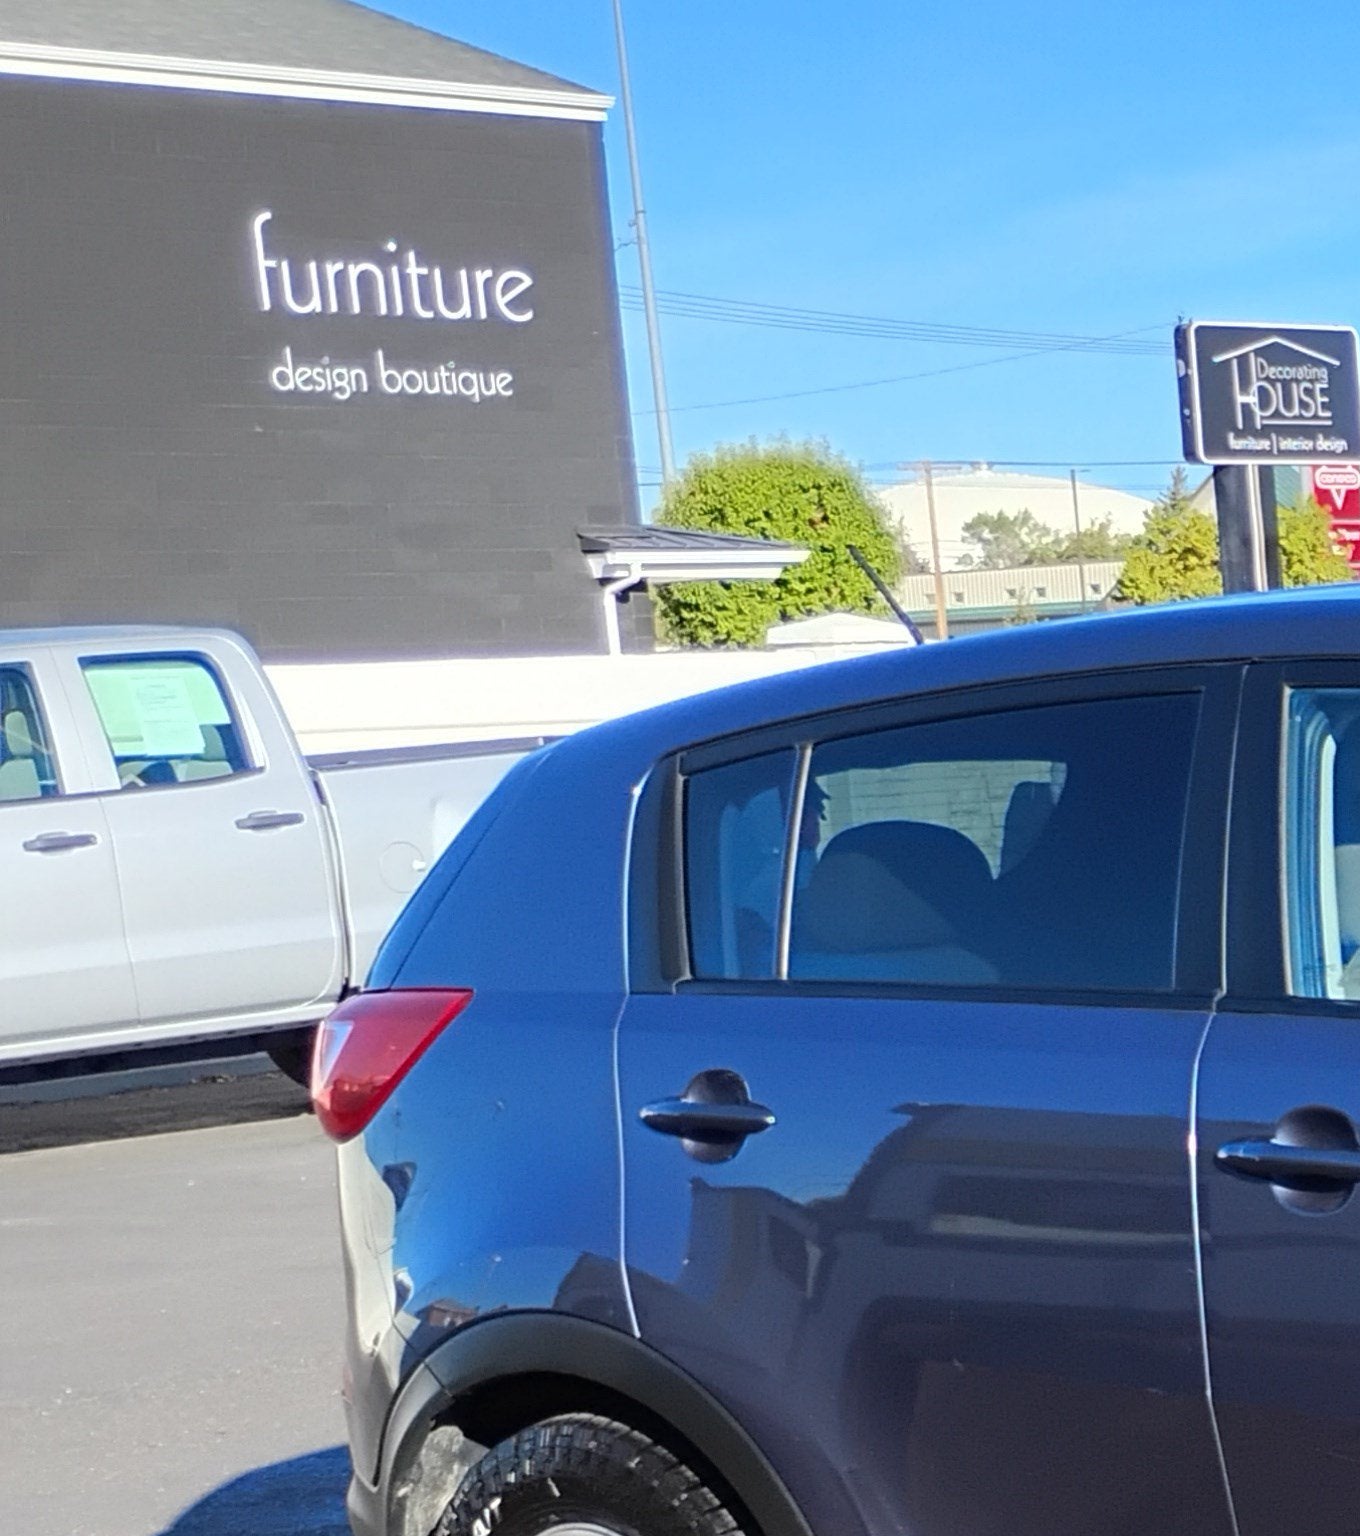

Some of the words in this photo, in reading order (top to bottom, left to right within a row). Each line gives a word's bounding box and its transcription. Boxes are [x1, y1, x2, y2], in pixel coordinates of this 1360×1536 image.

[253, 210, 535, 323] furniture
[271, 345, 368, 401] design
[376, 348, 514, 403] boutique
[1231, 352, 1333, 430] HOUSE
[1256, 357, 1329, 384] Decorating
[1227, 431, 1271, 451] furniture
[1278, 435, 1314, 451] interior
[1315, 432, 1349, 454] design
